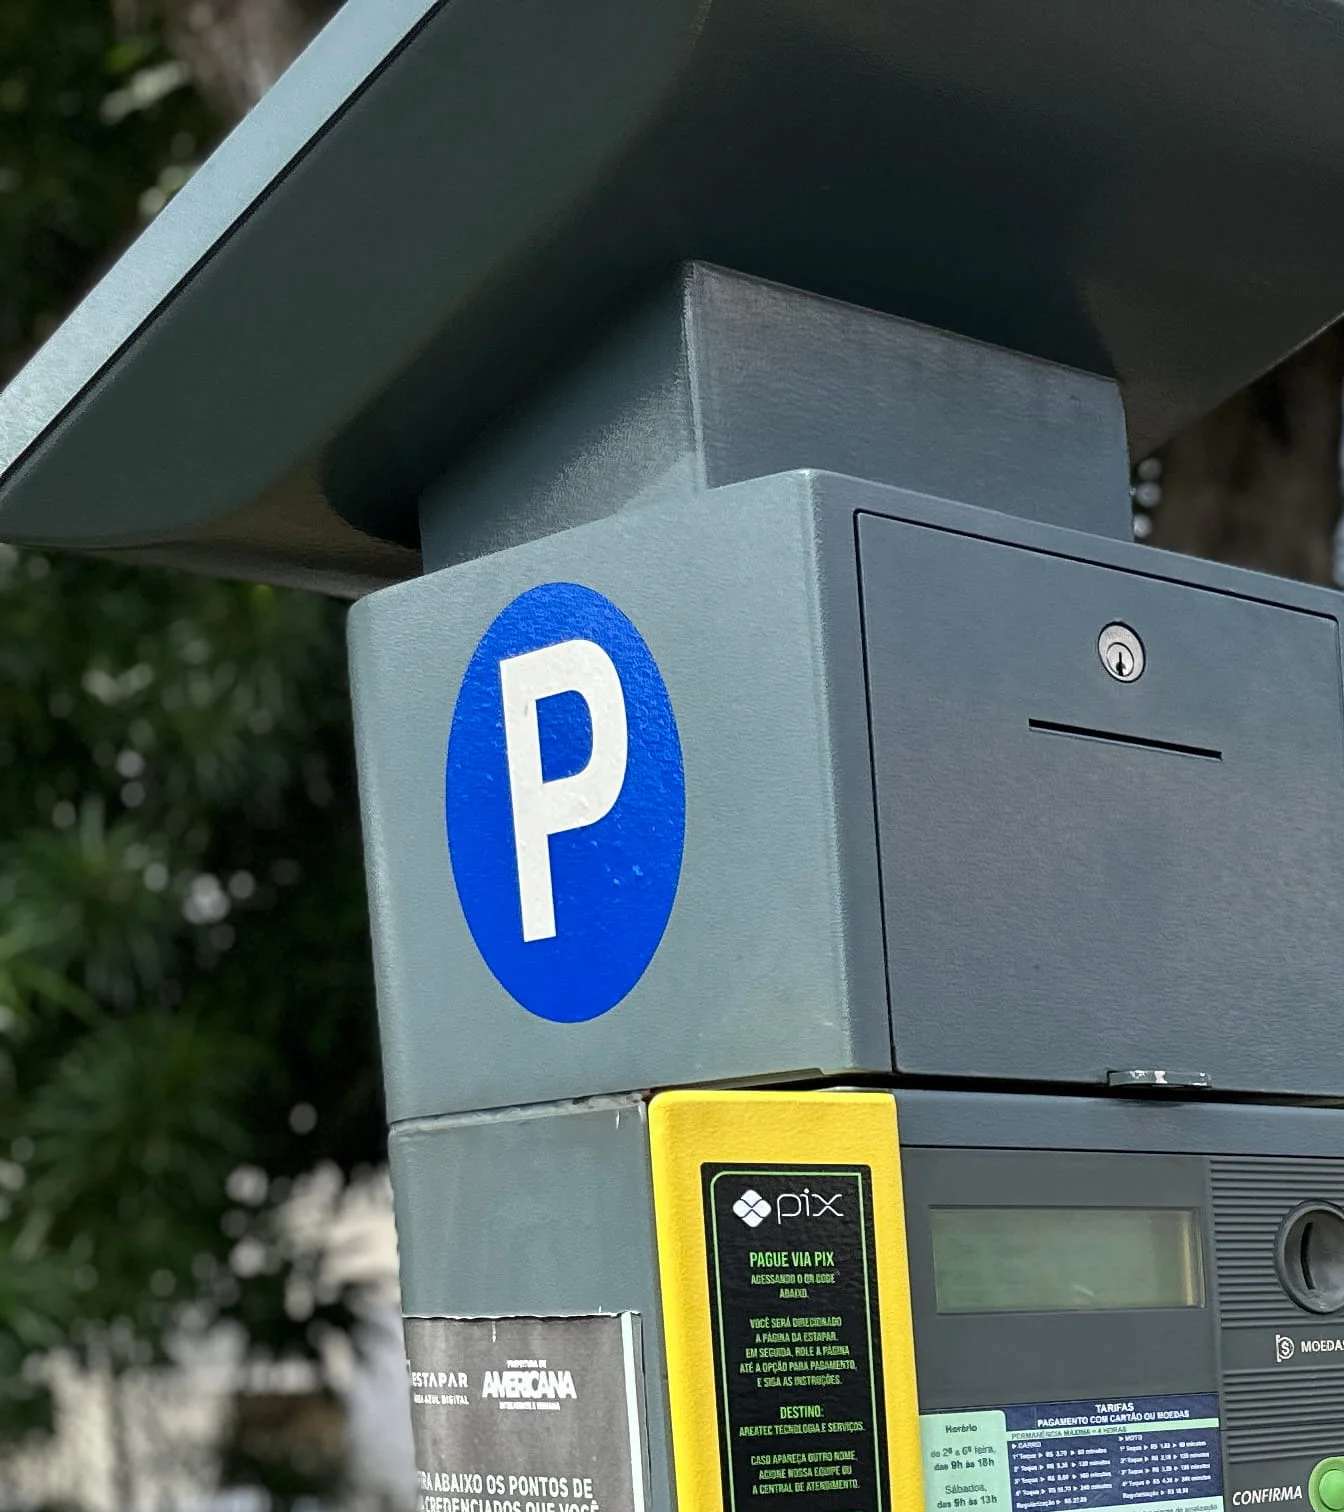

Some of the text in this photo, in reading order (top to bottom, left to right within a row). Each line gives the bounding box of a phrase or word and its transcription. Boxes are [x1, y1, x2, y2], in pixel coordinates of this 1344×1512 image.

[500, 639, 628, 942] P
[777, 1188, 844, 1224] pix
[750, 1252, 834, 1267] PAGUE VIA PIX
[750, 1316, 791, 1328] VOCÊ SERÁ
[740, 1361, 753, 1373] ATÉ
[412, 1373, 468, 1388] ESTAPAR
[482, 1371, 577, 1398] AMERICANA
[442, 1394, 469, 1405] DIGITAL
[780, 1405, 824, 1419] DESTINO:
[1096, 1403, 1134, 1413] TARIFAS
[1038, 1410, 1190, 1427] PAGAMENTO COM CARTÃO OU MOEDAS
[946, 1424, 977, 1433] Horário
[934, 1463, 949, 1471] das
[951, 1460, 963, 1469] 9h
[978, 1457, 995, 1467] 18h
[434, 1472, 482, 1493] ABAIXO
[487, 1475, 506, 1494] OS
[509, 1476, 568, 1497] PONTOS
[573, 1478, 593, 1498] DE
[945, 1483, 987, 1496] Sábados,
[937, 1494, 997, 1509] das 9h 13h
[1232, 1485, 1303, 1506] CONFIRMA
